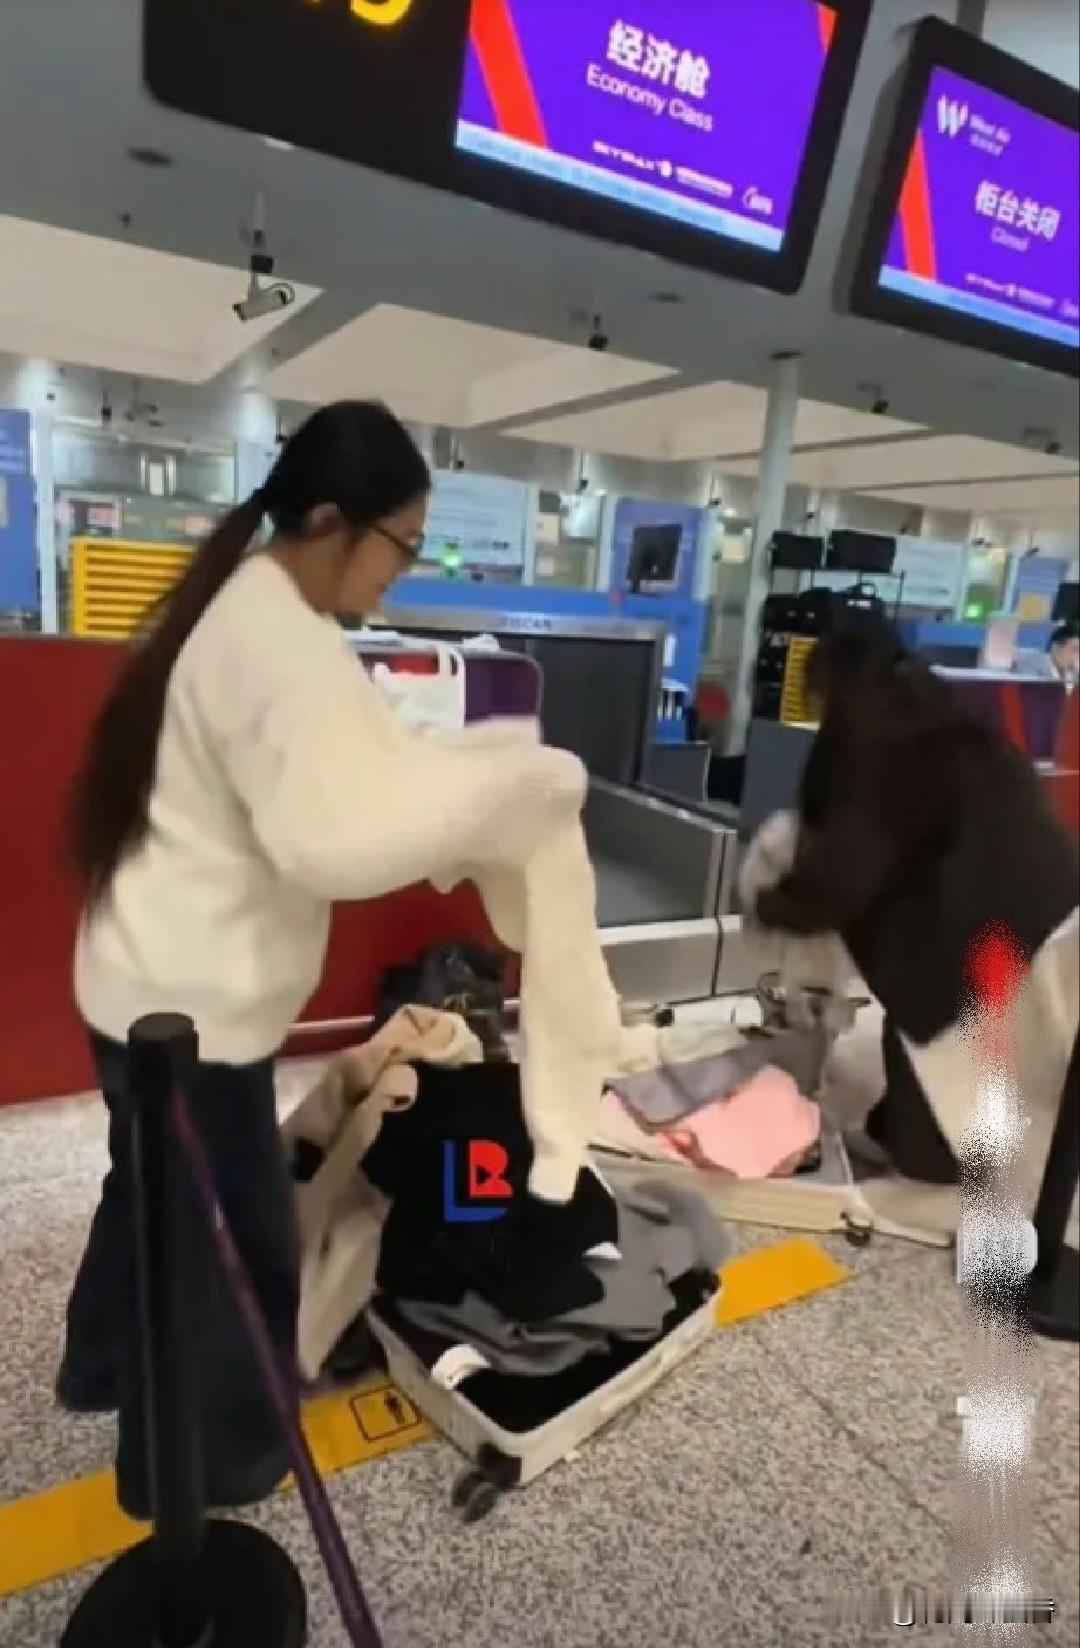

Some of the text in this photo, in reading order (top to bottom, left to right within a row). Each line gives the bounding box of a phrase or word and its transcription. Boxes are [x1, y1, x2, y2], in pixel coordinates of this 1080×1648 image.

[606, 20, 711, 99] 经济舱
[586, 63, 713, 132] Economy Class
[974, 180, 1062, 242] 柜台关闭
